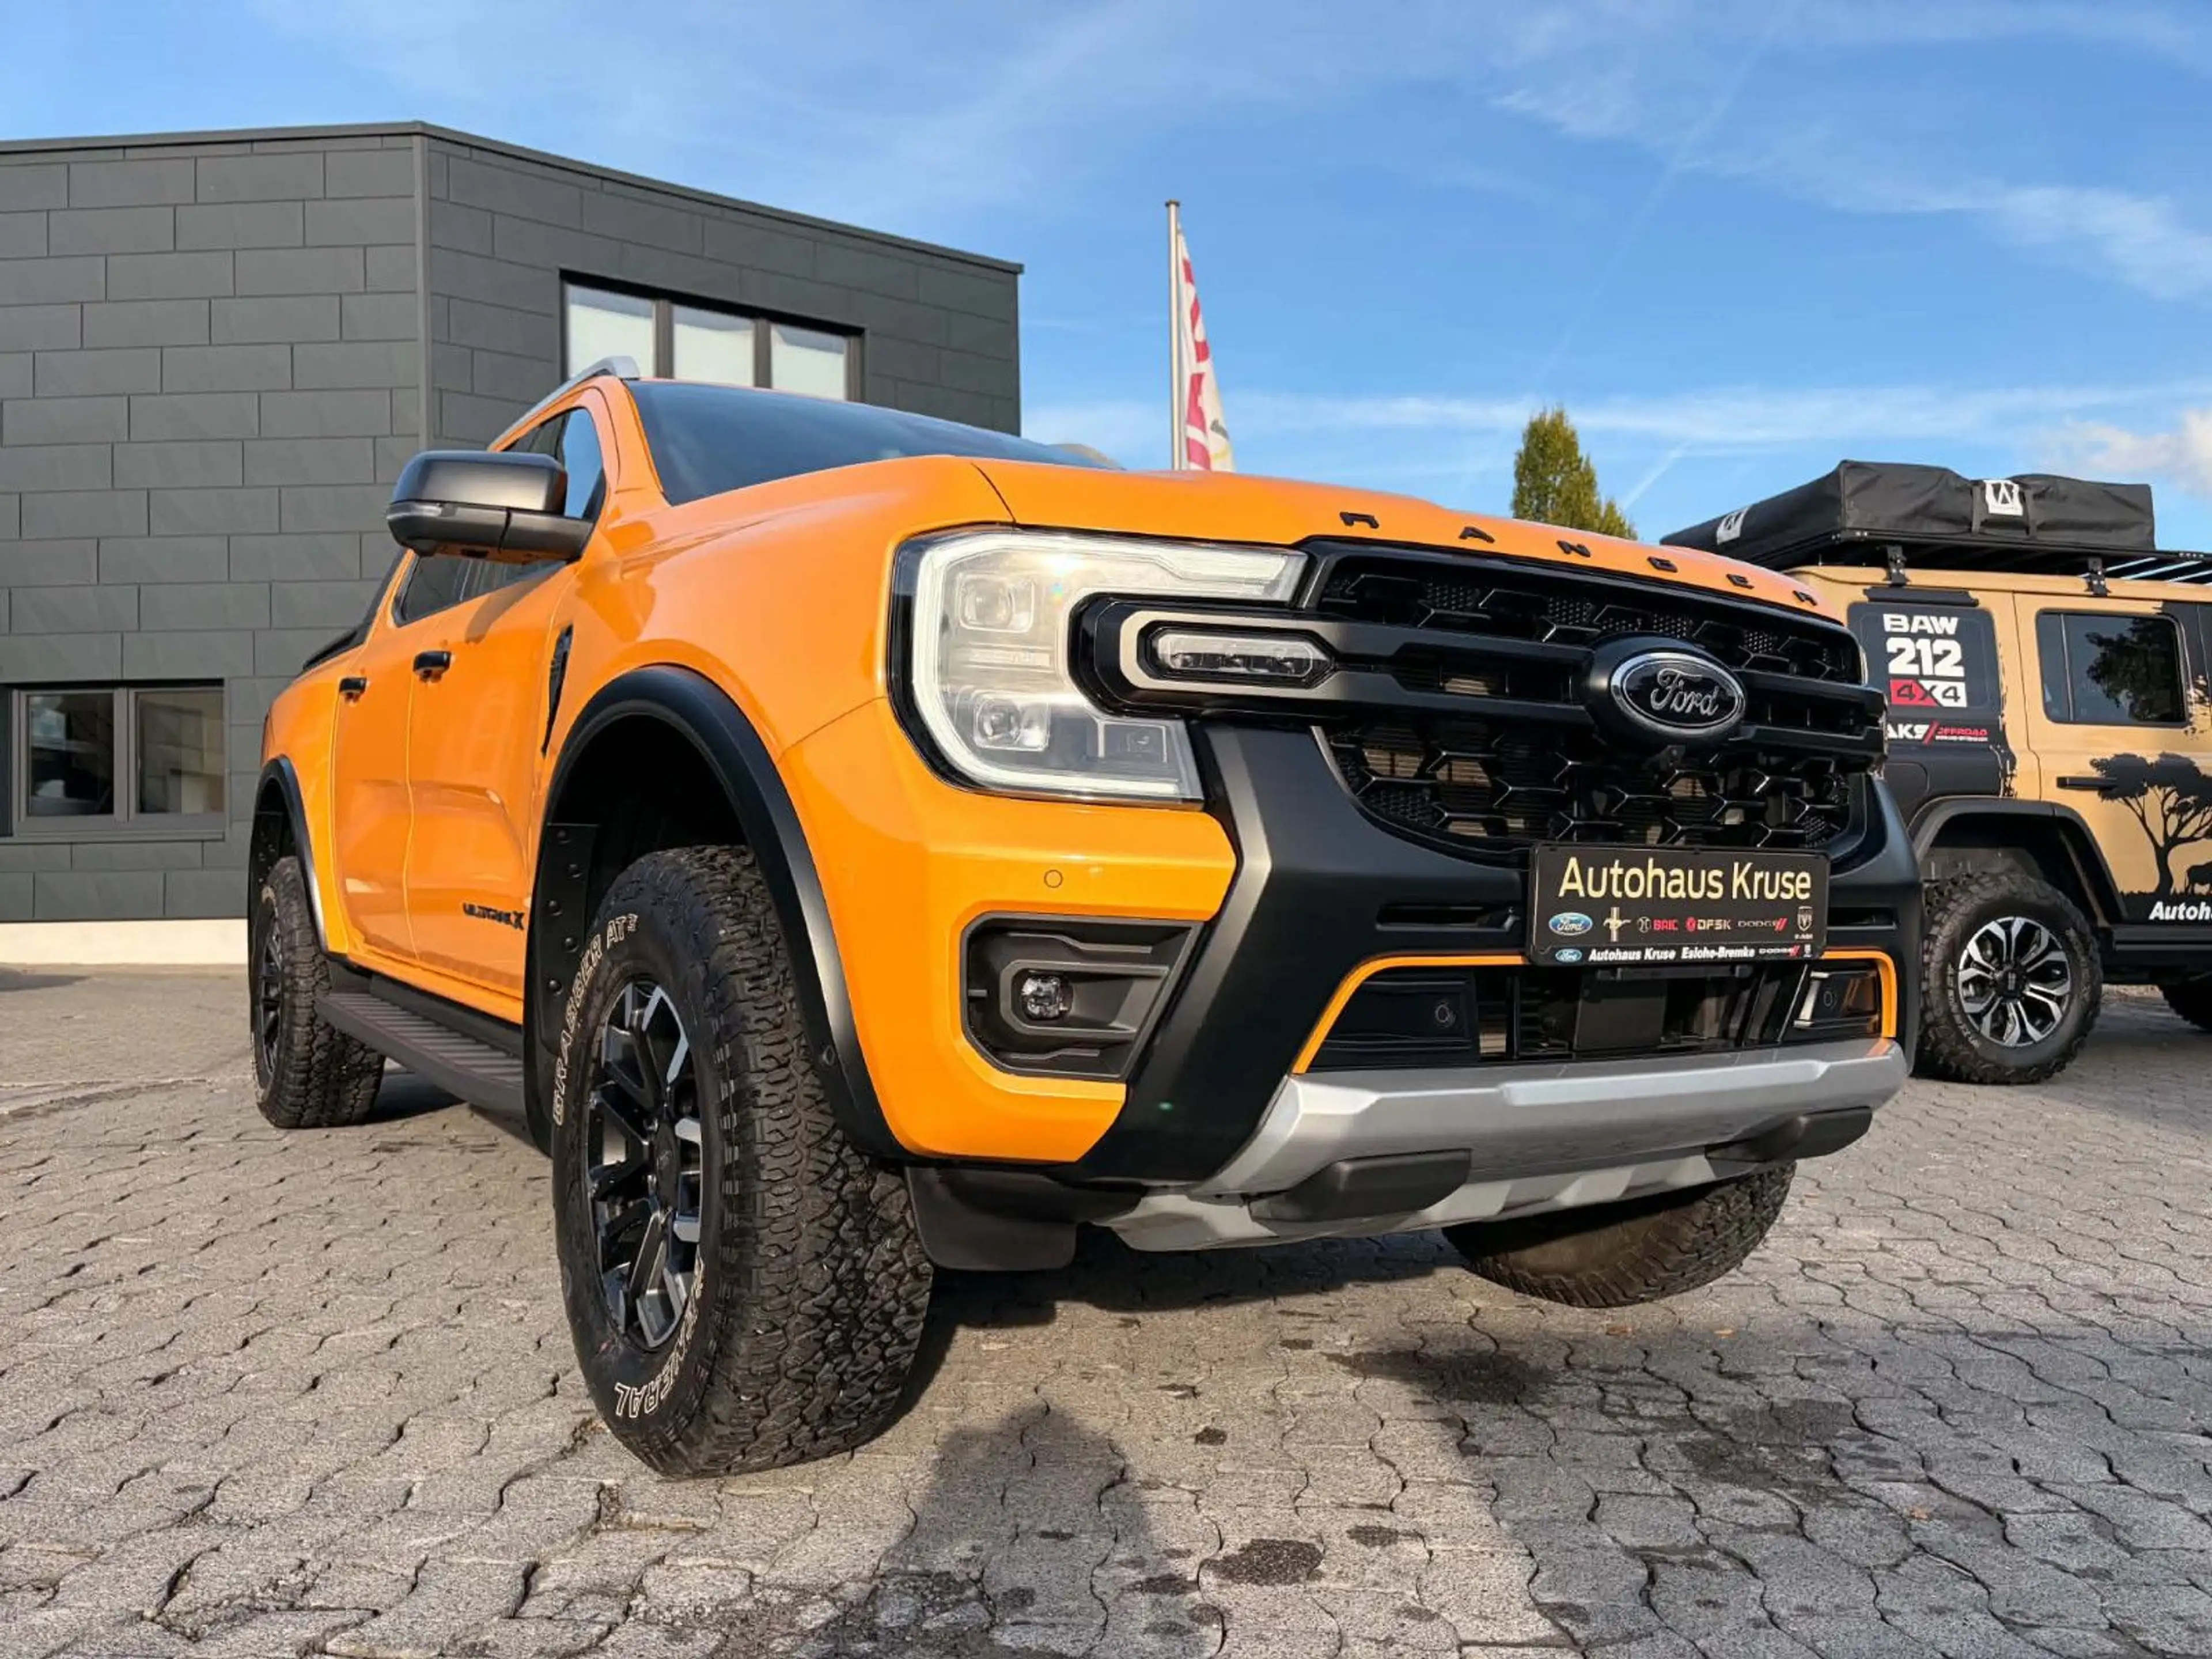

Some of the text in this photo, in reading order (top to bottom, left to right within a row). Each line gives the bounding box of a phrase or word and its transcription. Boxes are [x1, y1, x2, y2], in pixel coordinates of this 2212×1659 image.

[1339, 511, 1818, 607] RANGER
[1883, 613, 1959, 635] BAW
[1886, 637, 1965, 677] 212
[1650, 668, 1719, 717] Ford
[1558, 857, 1812, 900] Autohaus Kruse
[1697, 918, 1732, 930] DFSK
[2148, 900, 2212, 921] Autoh
[1589, 948, 1641, 962] Autohaus
[1644, 947, 1676, 960] Kruse
